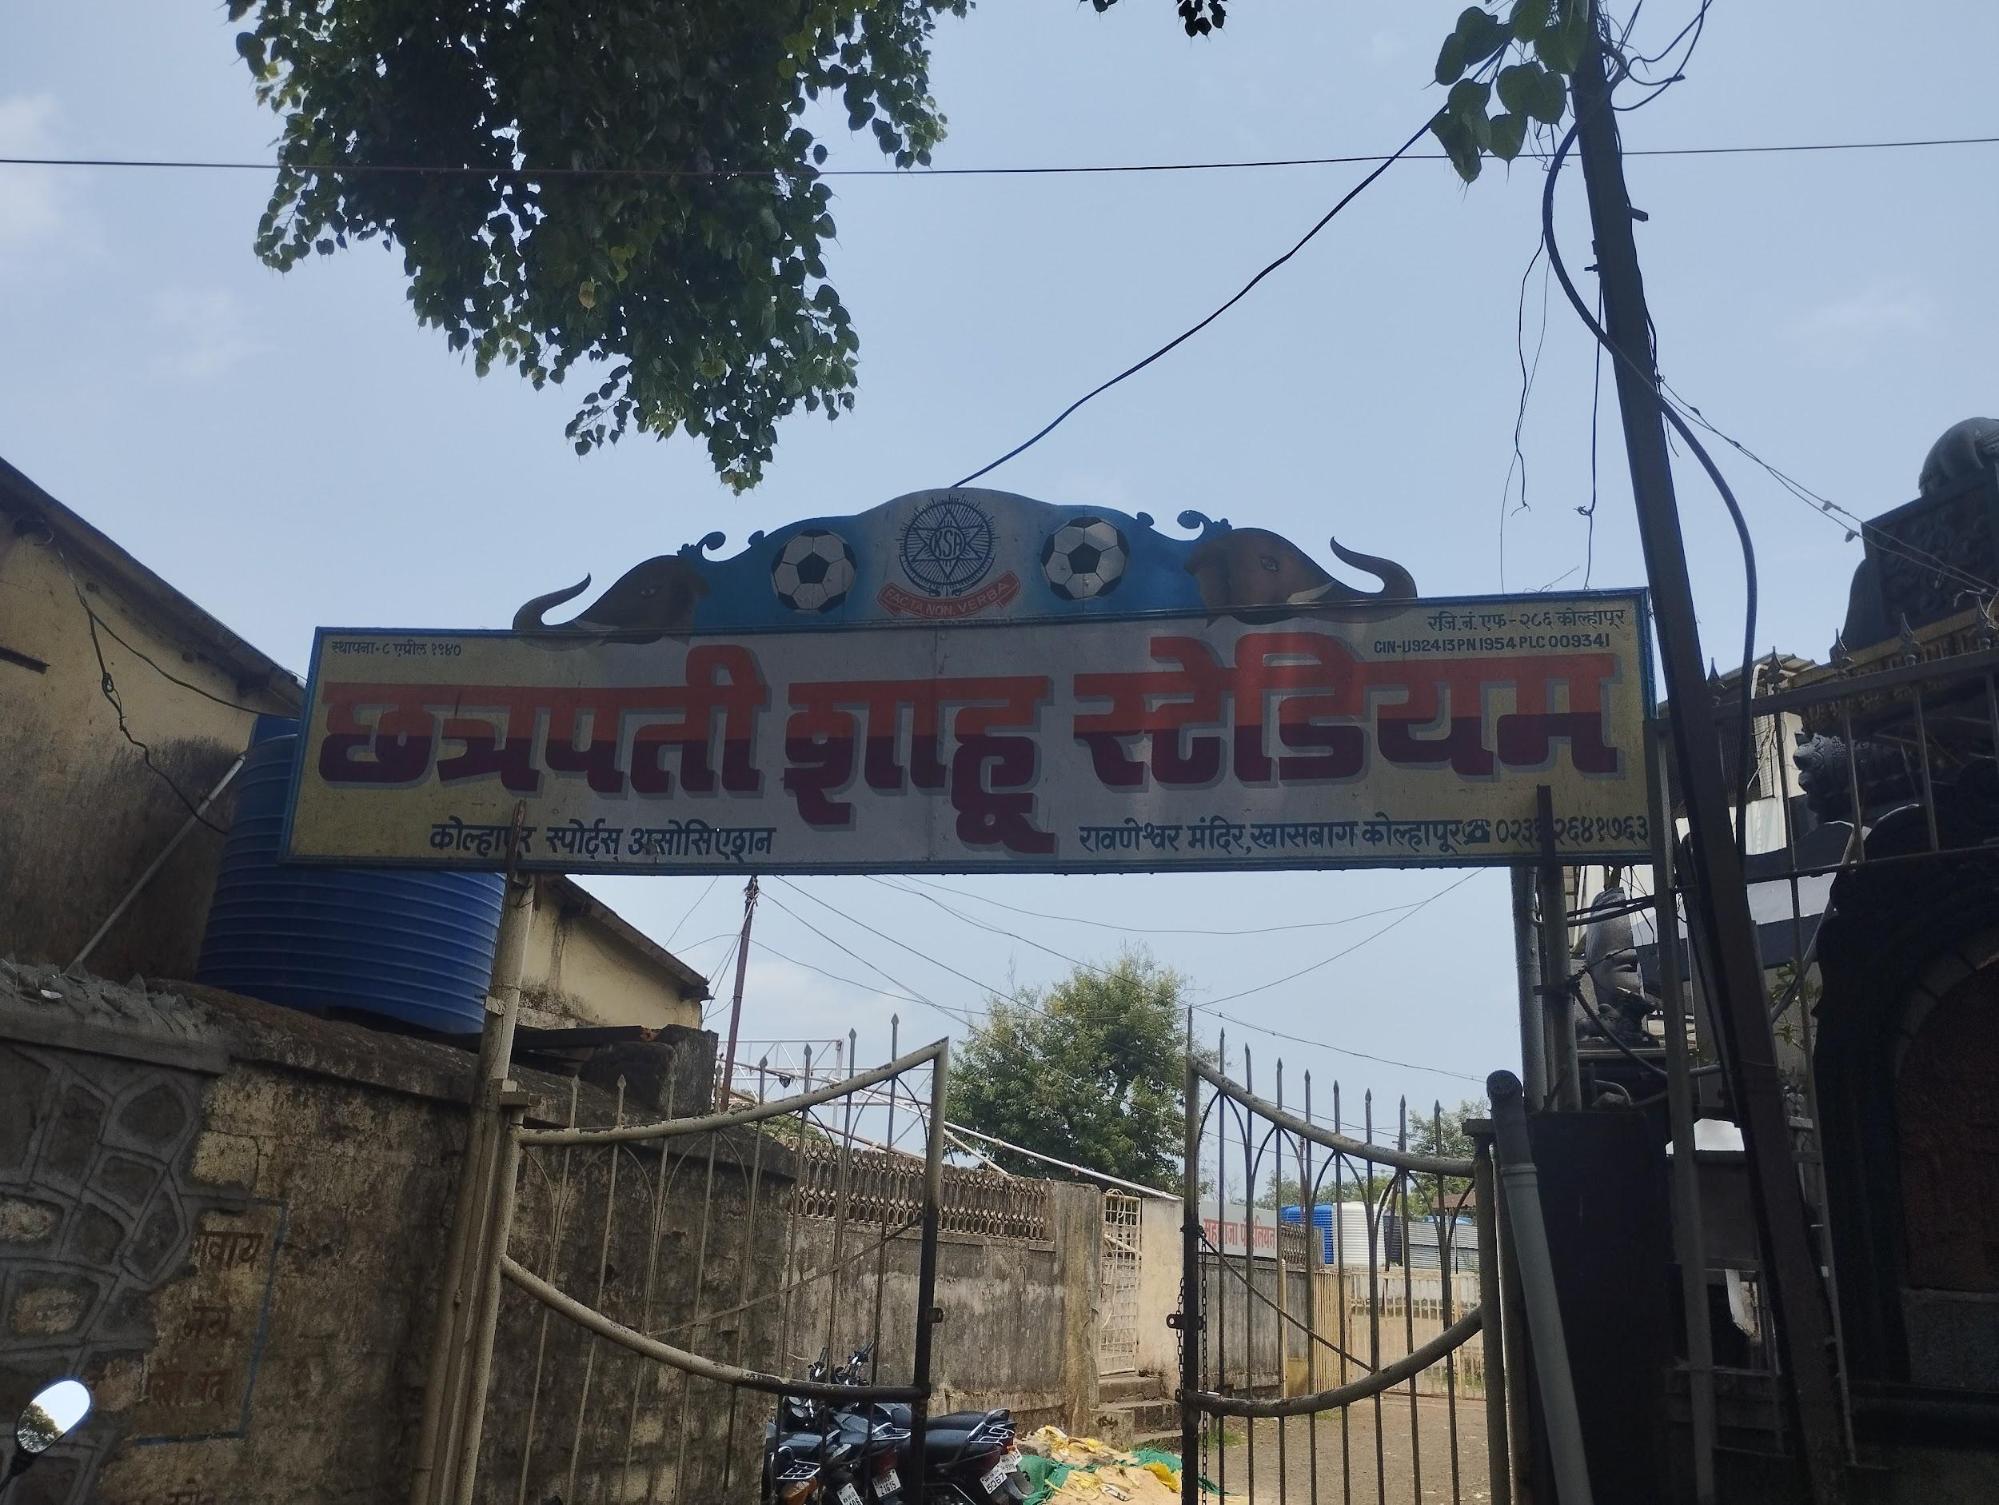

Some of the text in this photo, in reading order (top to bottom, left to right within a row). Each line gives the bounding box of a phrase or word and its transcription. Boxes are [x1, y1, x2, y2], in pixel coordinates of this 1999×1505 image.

[932, 529, 964, 558] KSA
[1556, 606, 1626, 631] कोल्हापूर
[318, 631, 1618, 855] छत्रपती शाहू स्टेडियम
[1078, 816, 1183, 852] रावणेश्वर
[1361, 811, 1463, 855] कोल्हापूर
